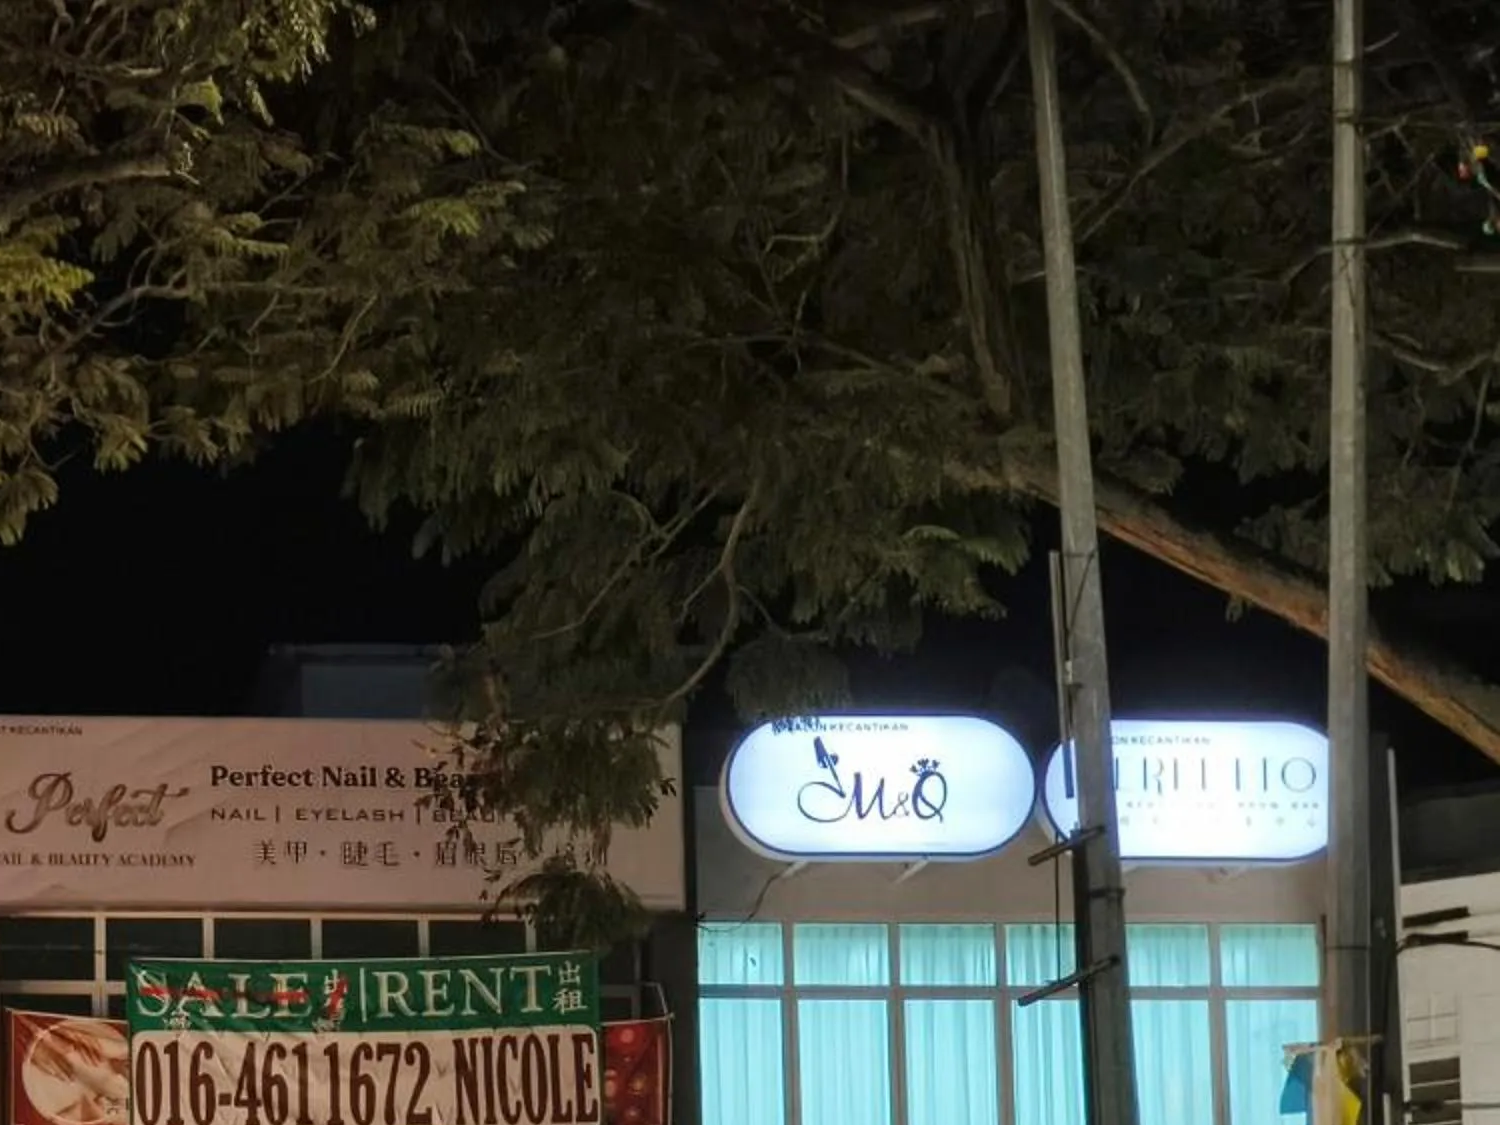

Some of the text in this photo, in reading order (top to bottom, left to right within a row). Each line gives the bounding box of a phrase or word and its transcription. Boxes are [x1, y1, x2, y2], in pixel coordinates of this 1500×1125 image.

[210, 766, 314, 788] Perfect
[322, 766, 379, 788] Nail
[384, 766, 407, 788] &
[210, 807, 267, 822] NAIL
[295, 807, 405, 823] EYELASH
[117, 852, 197, 868] ACADEMY
[134, 969, 314, 1020] SALE
[372, 965, 552, 1018] RENT
[452, 1033, 599, 1125] NICOLE
